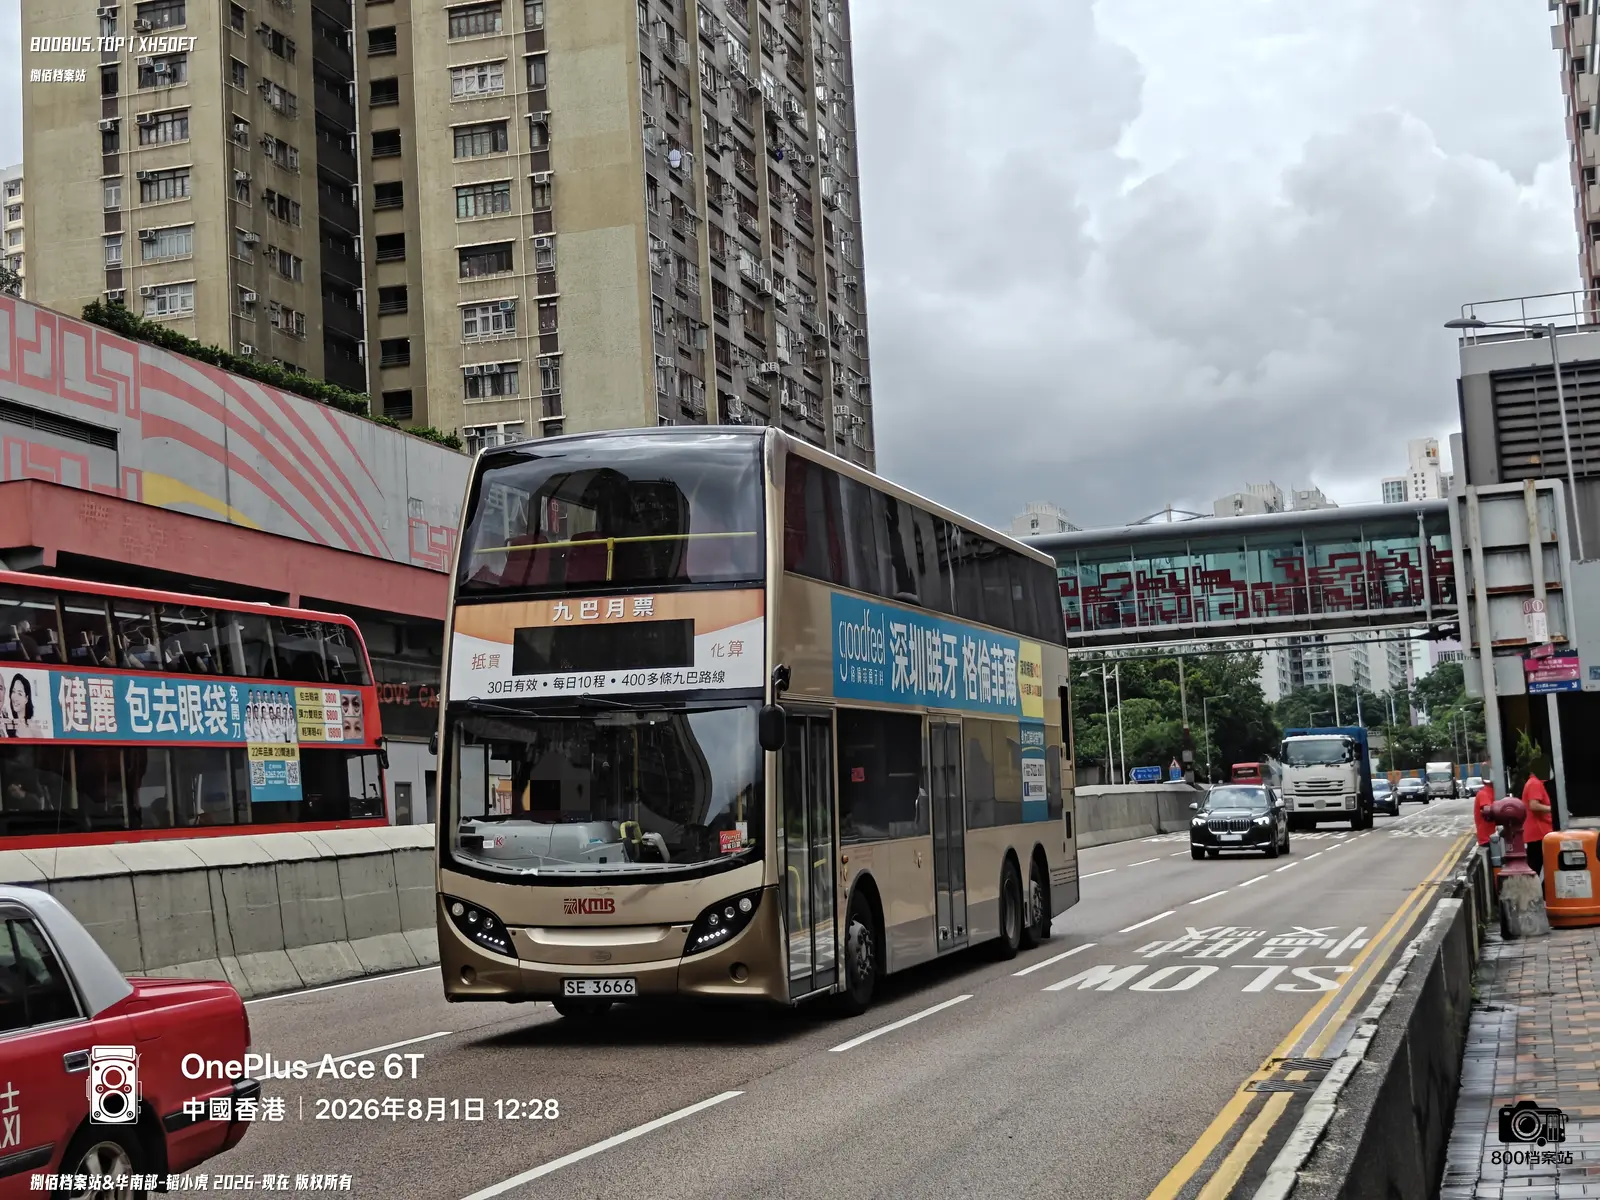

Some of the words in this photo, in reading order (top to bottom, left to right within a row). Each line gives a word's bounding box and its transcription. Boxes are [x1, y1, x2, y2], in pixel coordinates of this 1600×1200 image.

[552, 596, 655, 622] 九巴月票
[710, 640, 745, 657] 化算
[838, 608, 886, 682] goodfeel
[471, 652, 501, 671] 抵買
[889, 621, 958, 699] 深圳睇牙
[962, 634, 1017, 706] 格倫菲爾
[487, 678, 538, 694] 30日有效
[552, 674, 606, 690] 每日10程
[621, 670, 726, 687] 400多條九巴路線
[58, 675, 118, 733] 健麗
[125, 680, 228, 735] 包去眼袋
[578, 898, 616, 915] KMB
[566, 981, 586, 994] SE
[593, 980, 634, 994] 3666
[1041, 964, 1356, 992] SLOW
